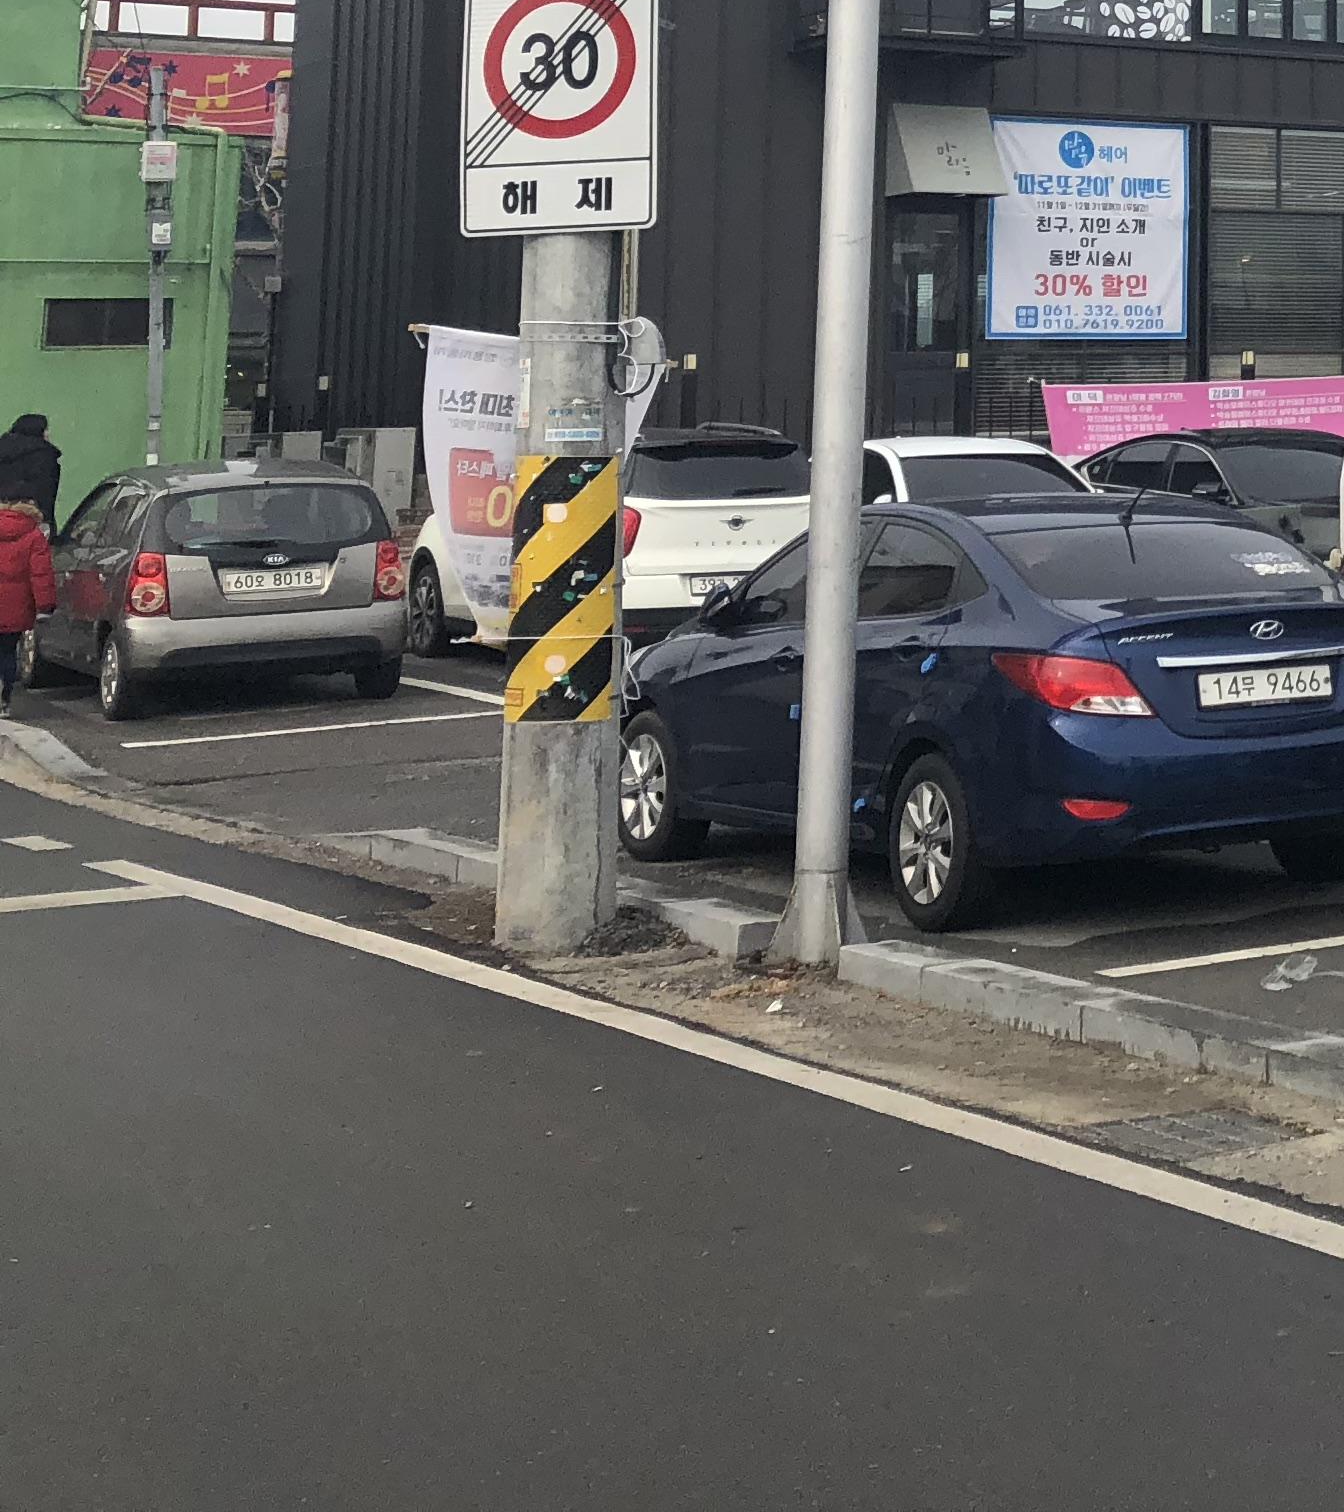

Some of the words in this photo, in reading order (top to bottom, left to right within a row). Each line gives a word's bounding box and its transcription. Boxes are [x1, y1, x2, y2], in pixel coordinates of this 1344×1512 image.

[519, 30, 599, 92] 30
[1098, 146, 1128, 163] 헤어
[1120, 176, 1172, 199] 이벤트
[1037, 216, 1074, 234] 친구,
[1079, 217, 1111, 234] 지인
[1116, 218, 1146, 235] 소개
[1079, 238, 1097, 248] or
[1049, 250, 1081, 267] 동반
[1085, 251, 1132, 267] 시술시
[1034, 273, 1093, 297] 30%
[1101, 273, 1148, 298] 할인
[265, 555, 287, 564] KIA
[234, 573, 265, 589] 60오
[272, 571, 314, 586] 8018
[1213, 675, 1255, 700] 14무
[1266, 670, 1321, 695] 9466
